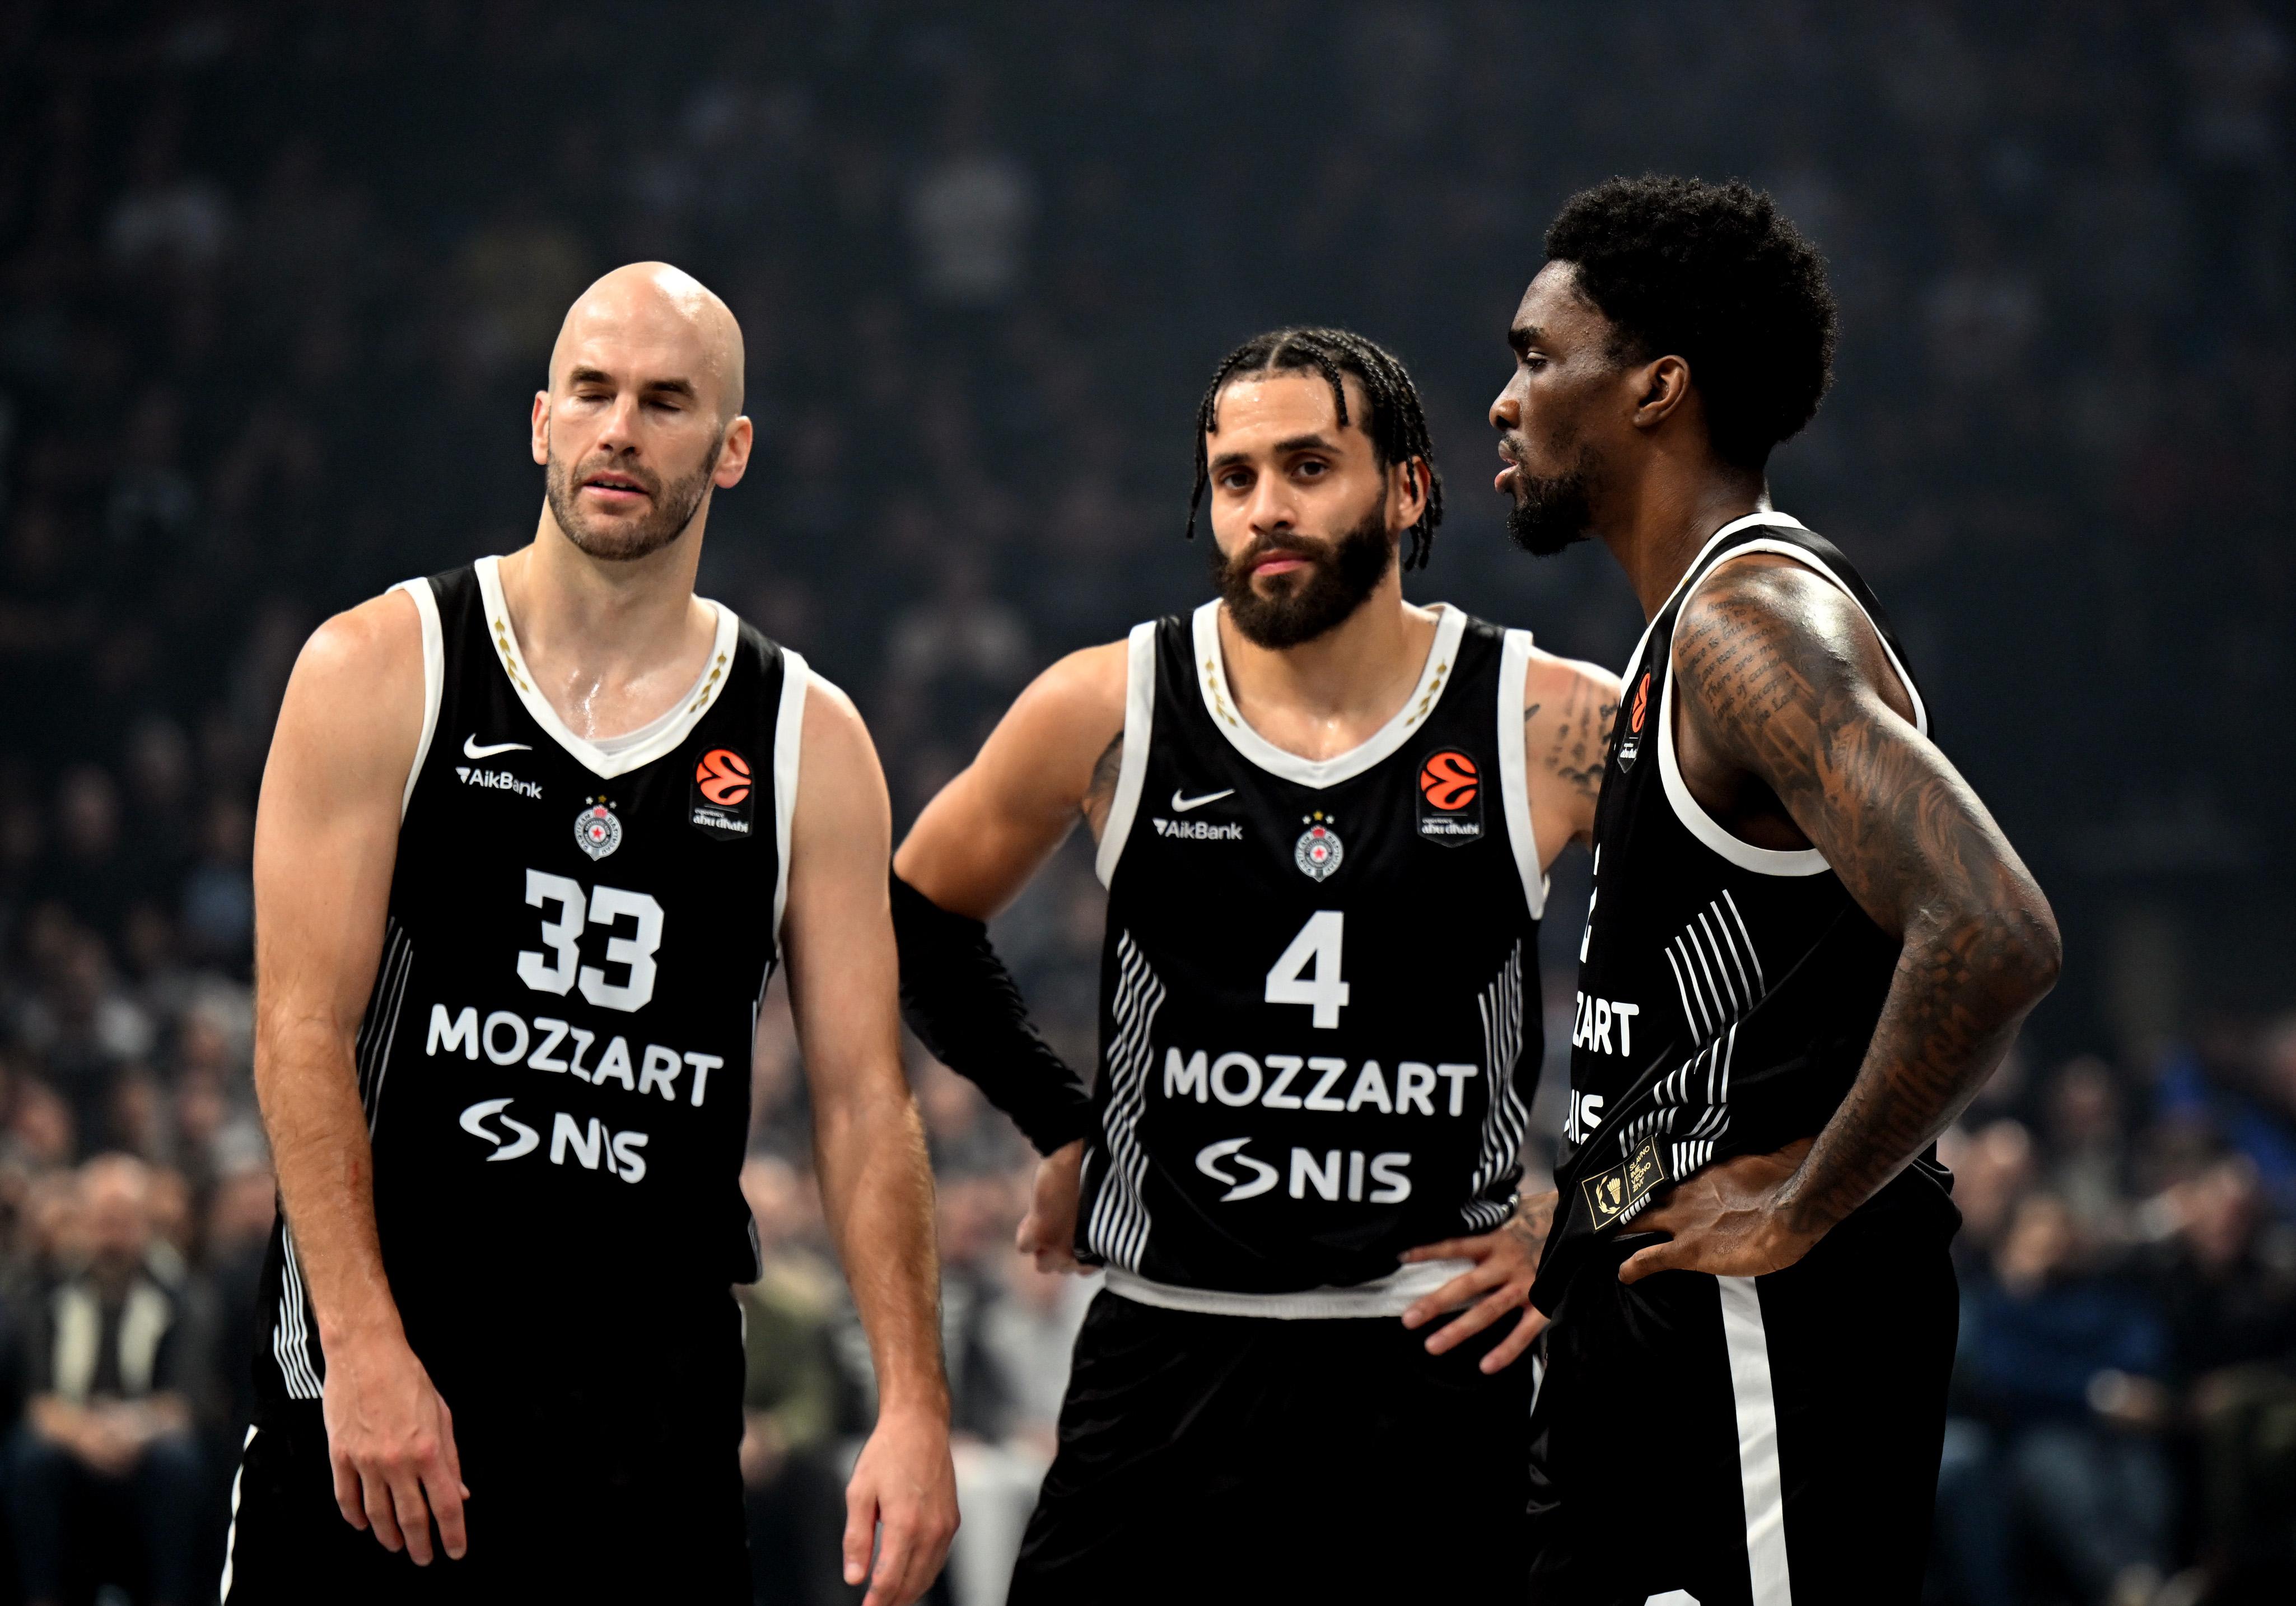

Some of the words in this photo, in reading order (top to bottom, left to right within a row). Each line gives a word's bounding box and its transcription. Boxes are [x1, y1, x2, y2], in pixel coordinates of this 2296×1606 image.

[469, 768, 543, 800] AikBank
[693, 814, 716, 827] abu
[1165, 820, 1243, 840] AikBank
[517, 869, 665, 1013] 33
[1265, 911, 1350, 1029] 4
[426, 1004, 724, 1107] MOZZART
[1164, 1047, 1478, 1117] MOZZART
[550, 1113, 648, 1184] NIS
[1289, 1148, 1411, 1203] NIS
[1630, 1146, 1650, 1171] SLAVNO
